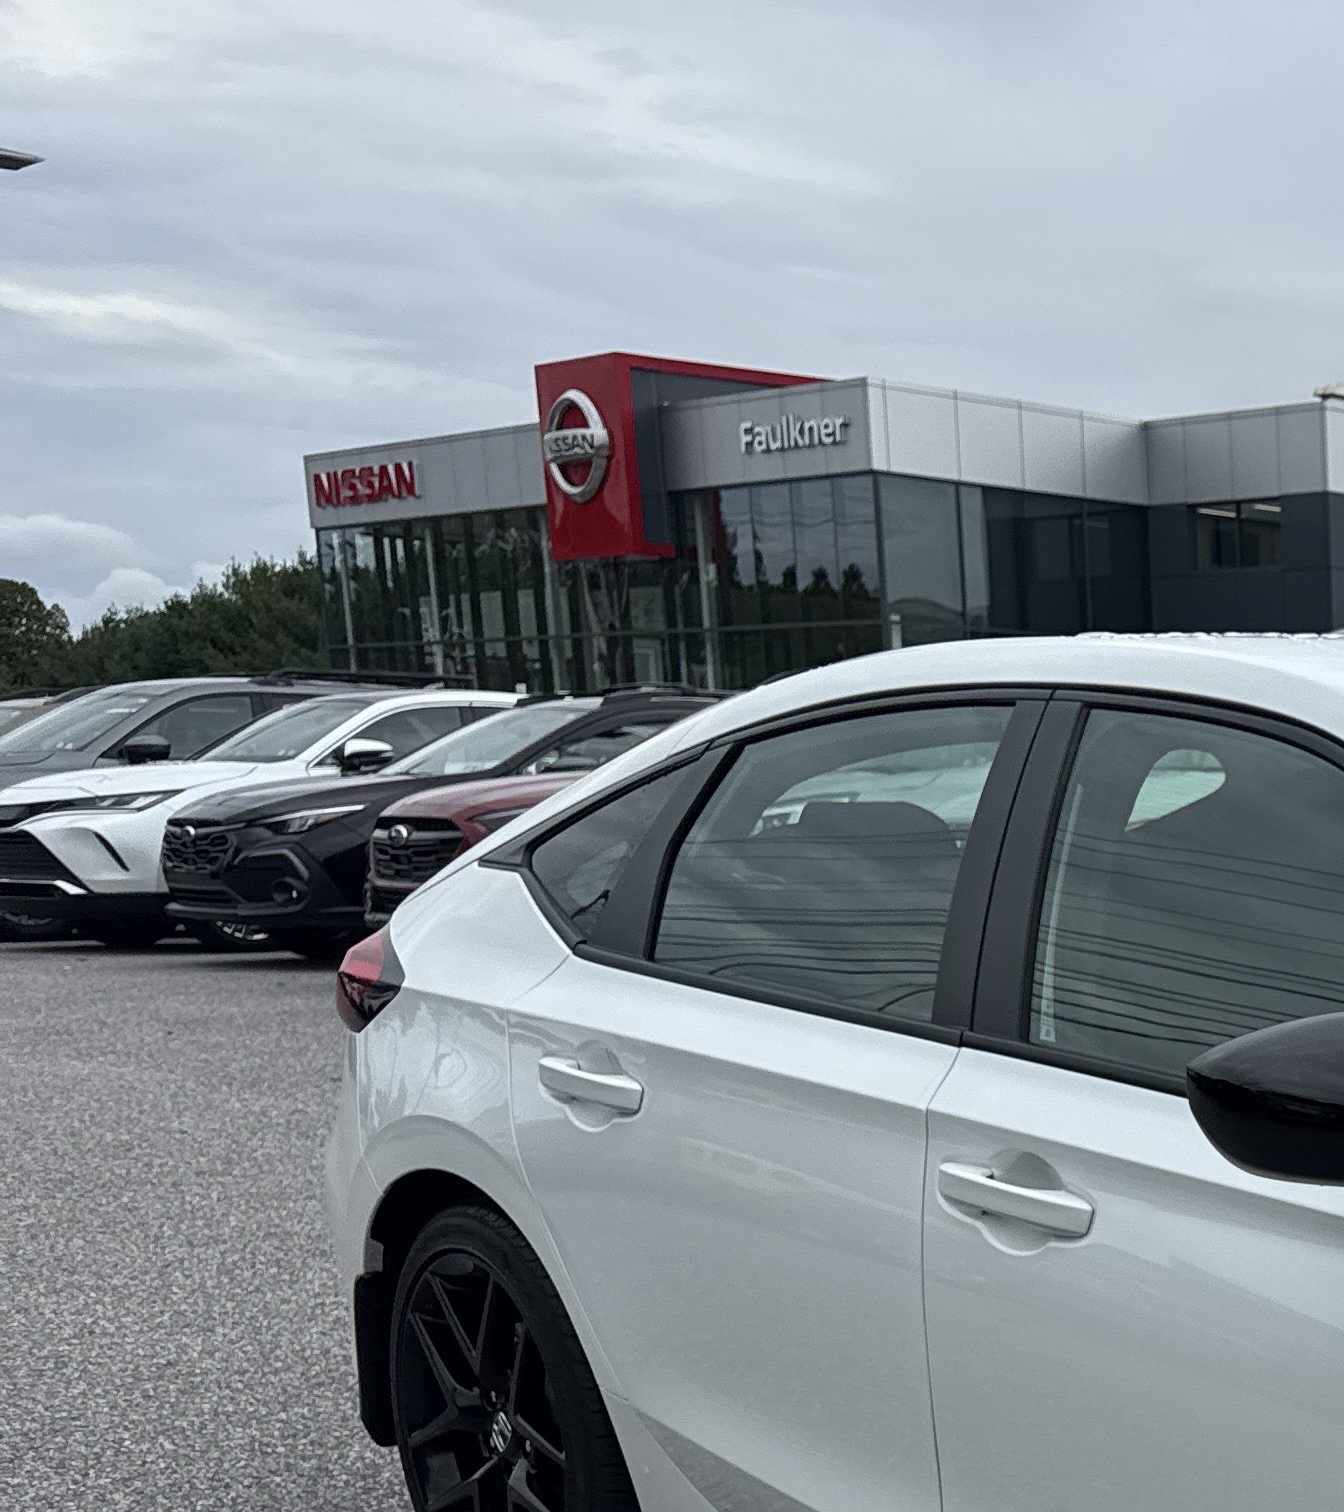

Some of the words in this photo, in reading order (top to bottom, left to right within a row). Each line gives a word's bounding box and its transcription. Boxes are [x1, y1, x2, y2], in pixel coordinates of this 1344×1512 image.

[549, 433, 595, 453] SSAN
[739, 413, 846, 453] Faulkner
[313, 461, 416, 508] NISSAN
